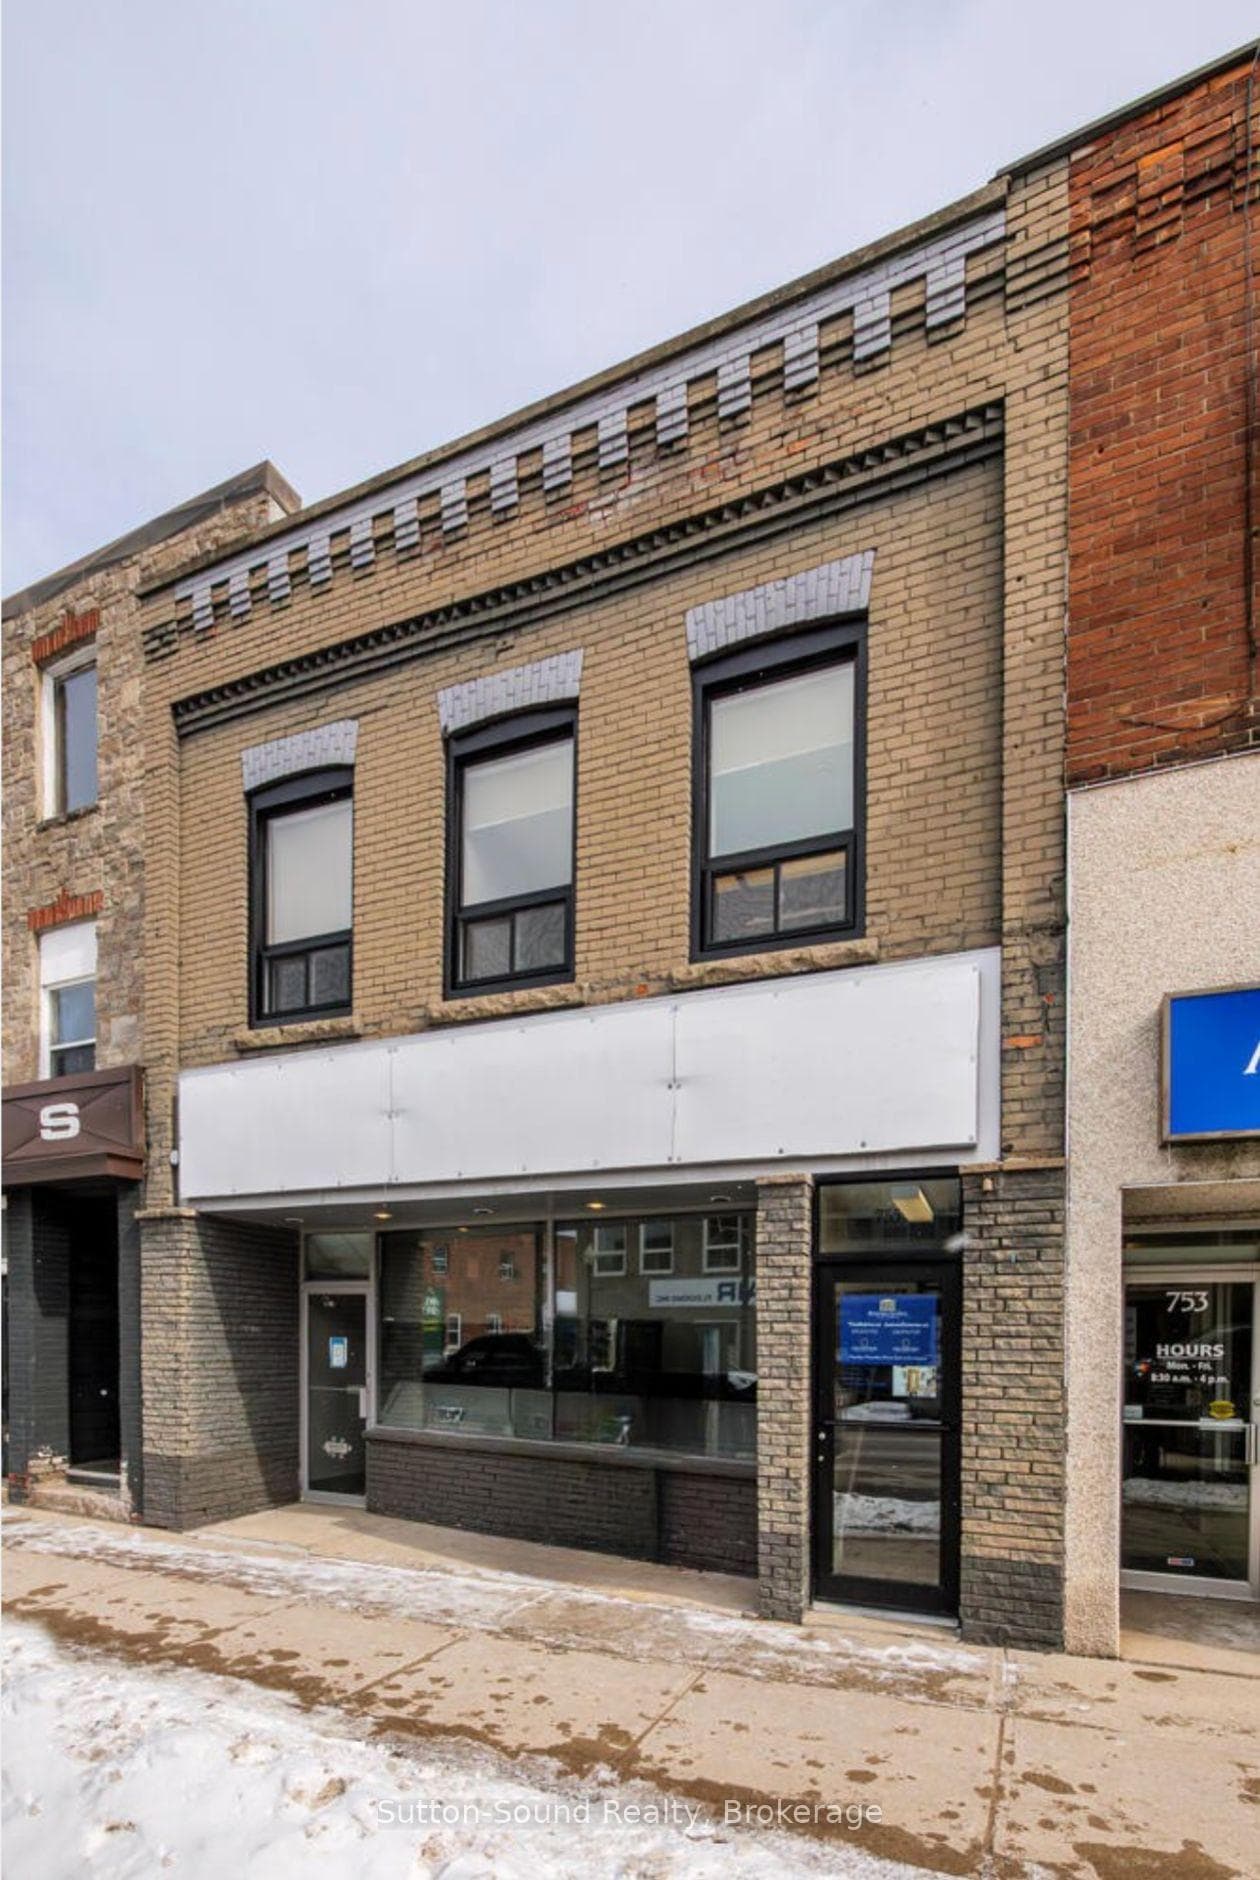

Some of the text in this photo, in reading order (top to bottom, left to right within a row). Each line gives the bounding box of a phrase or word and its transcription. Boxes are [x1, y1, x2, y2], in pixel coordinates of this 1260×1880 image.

[40, 1102, 81, 1141] S
[1166, 1291, 1209, 1313] 753
[1156, 1343, 1224, 1358] HOURS
